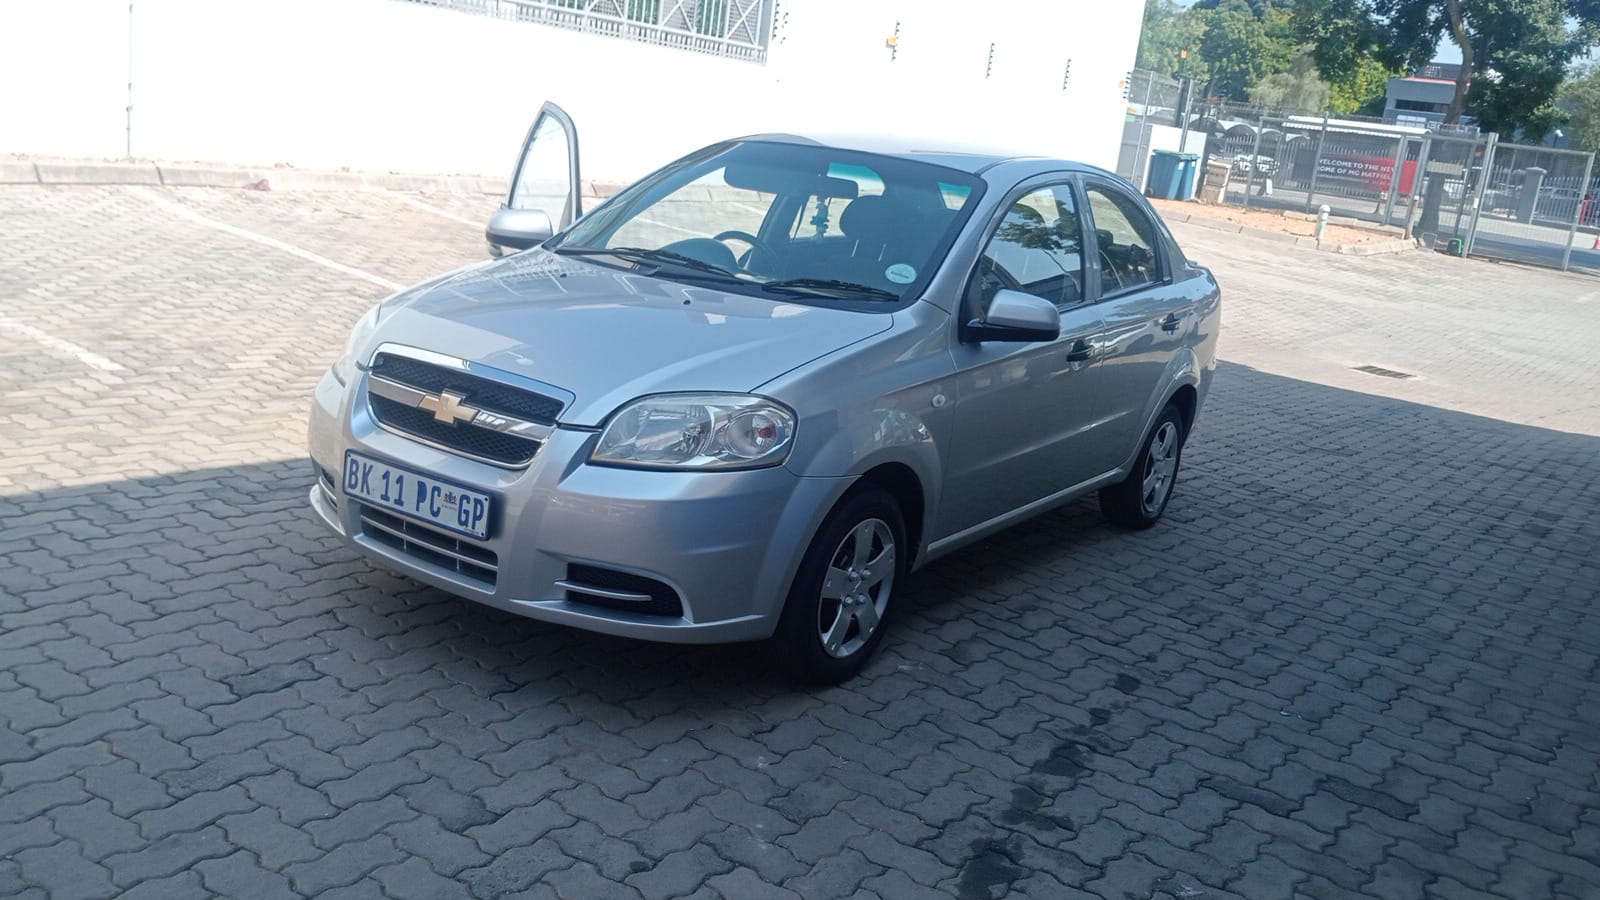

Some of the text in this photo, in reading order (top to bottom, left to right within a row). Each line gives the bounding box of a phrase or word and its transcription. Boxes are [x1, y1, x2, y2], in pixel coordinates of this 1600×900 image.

[1361, 171, 1391, 179] HATFIEL
[348, 458, 485, 530] BK 11 PC GP
